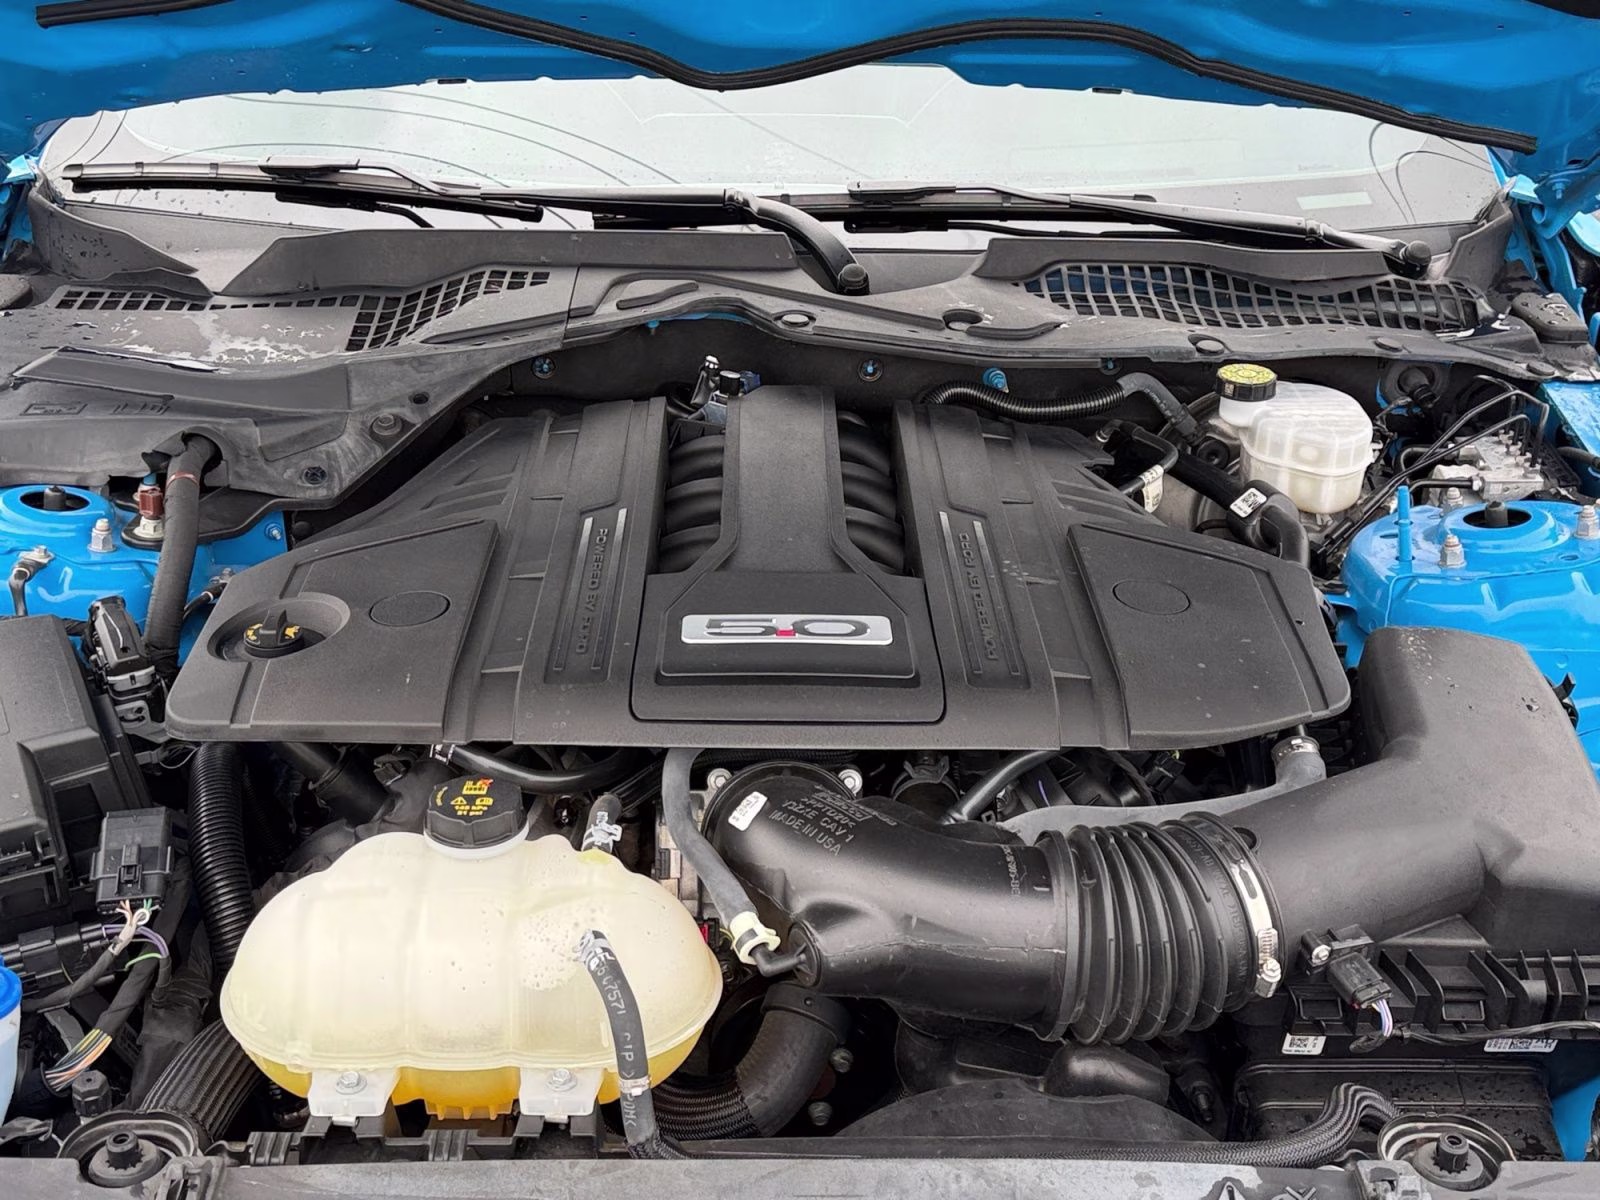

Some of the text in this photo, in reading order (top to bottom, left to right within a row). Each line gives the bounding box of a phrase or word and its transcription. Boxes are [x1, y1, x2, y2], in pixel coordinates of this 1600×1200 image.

[588, 528, 608, 590] POWERED
[584, 593, 598, 611] BY
[959, 532, 998, 660] POWERED BY FORD
[704, 618, 872, 638] 5.0
[768, 810, 805, 830] MADE
[815, 832, 842, 857] USA
